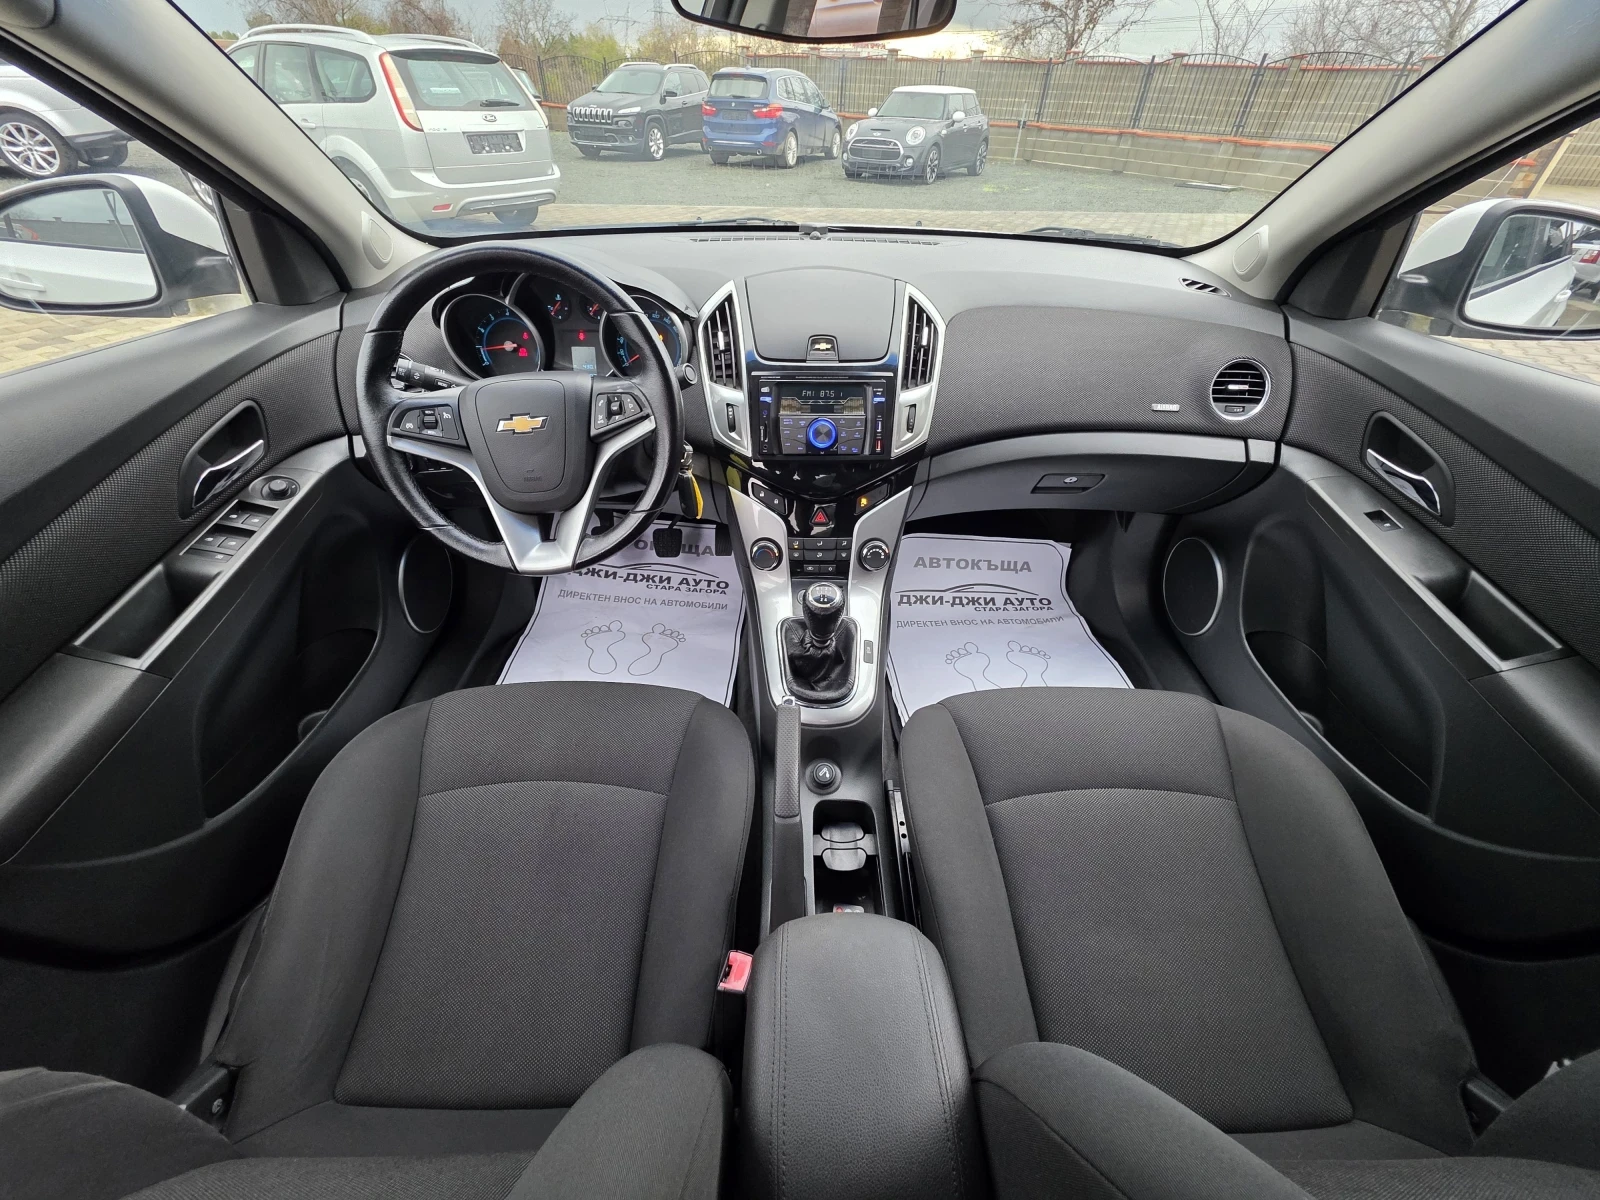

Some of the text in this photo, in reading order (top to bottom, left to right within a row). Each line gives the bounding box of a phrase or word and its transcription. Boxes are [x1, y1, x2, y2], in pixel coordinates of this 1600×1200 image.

[913, 556, 1032, 574] АВТОКЪЩА
[646, 583, 727, 595] СТАРА ЗАГОРА
[678, 577, 730, 590] АУТО
[557, 588, 728, 611] ДИРЕКТЕН ВНОС НА АВТОМОБИЛИ
[897, 594, 1052, 608] ДЖИ-ДЖИ АУТО
[896, 615, 1064, 629] ДИРЕКТЕН ВНОС НА АВТОМОБИЛИ
